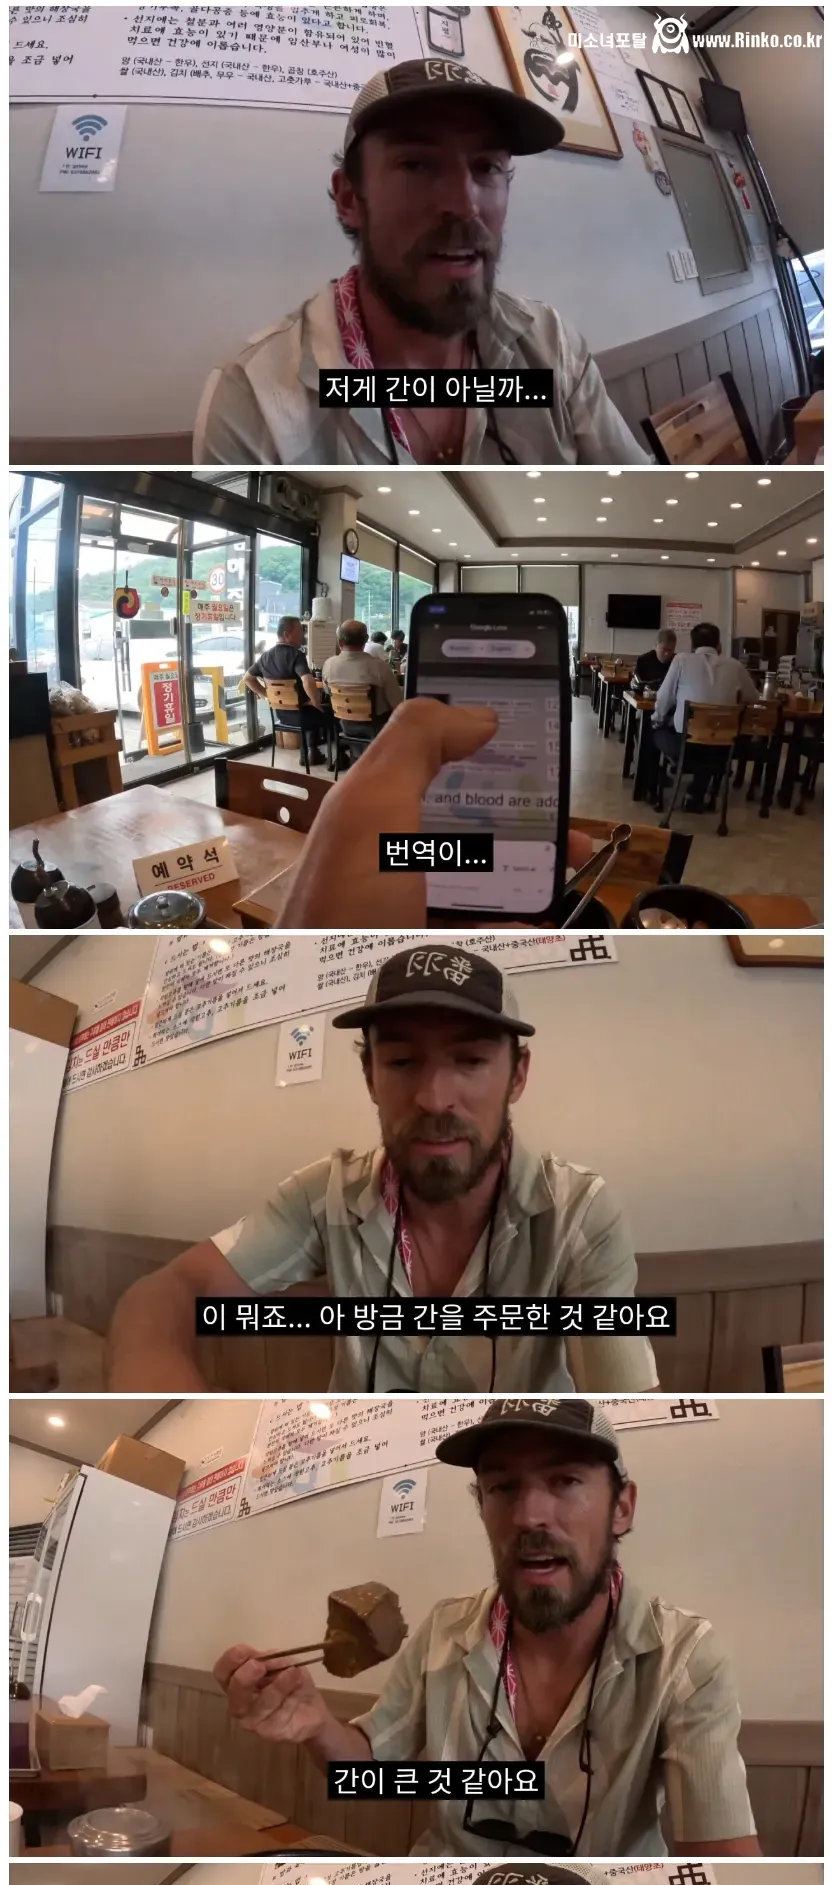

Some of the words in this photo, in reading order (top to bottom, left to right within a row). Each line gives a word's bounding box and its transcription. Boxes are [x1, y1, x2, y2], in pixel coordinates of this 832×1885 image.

[65, 146, 102, 160] WIFI
[212, 573, 224, 586] 30
[162, 682, 176, 724] 정기휴일
[434, 792, 461, 805] and
[465, 793, 504, 807] blood
[508, 796, 531, 807] are
[85, 1044, 101, 1063] 드실
[102, 1030, 131, 1056] 만큼만
[289, 1048, 312, 1060] WIFI
[191, 1495, 207, 1518] 드실
[208, 1486, 237, 1511] 만큼만
[391, 1501, 414, 1513] WIFI
